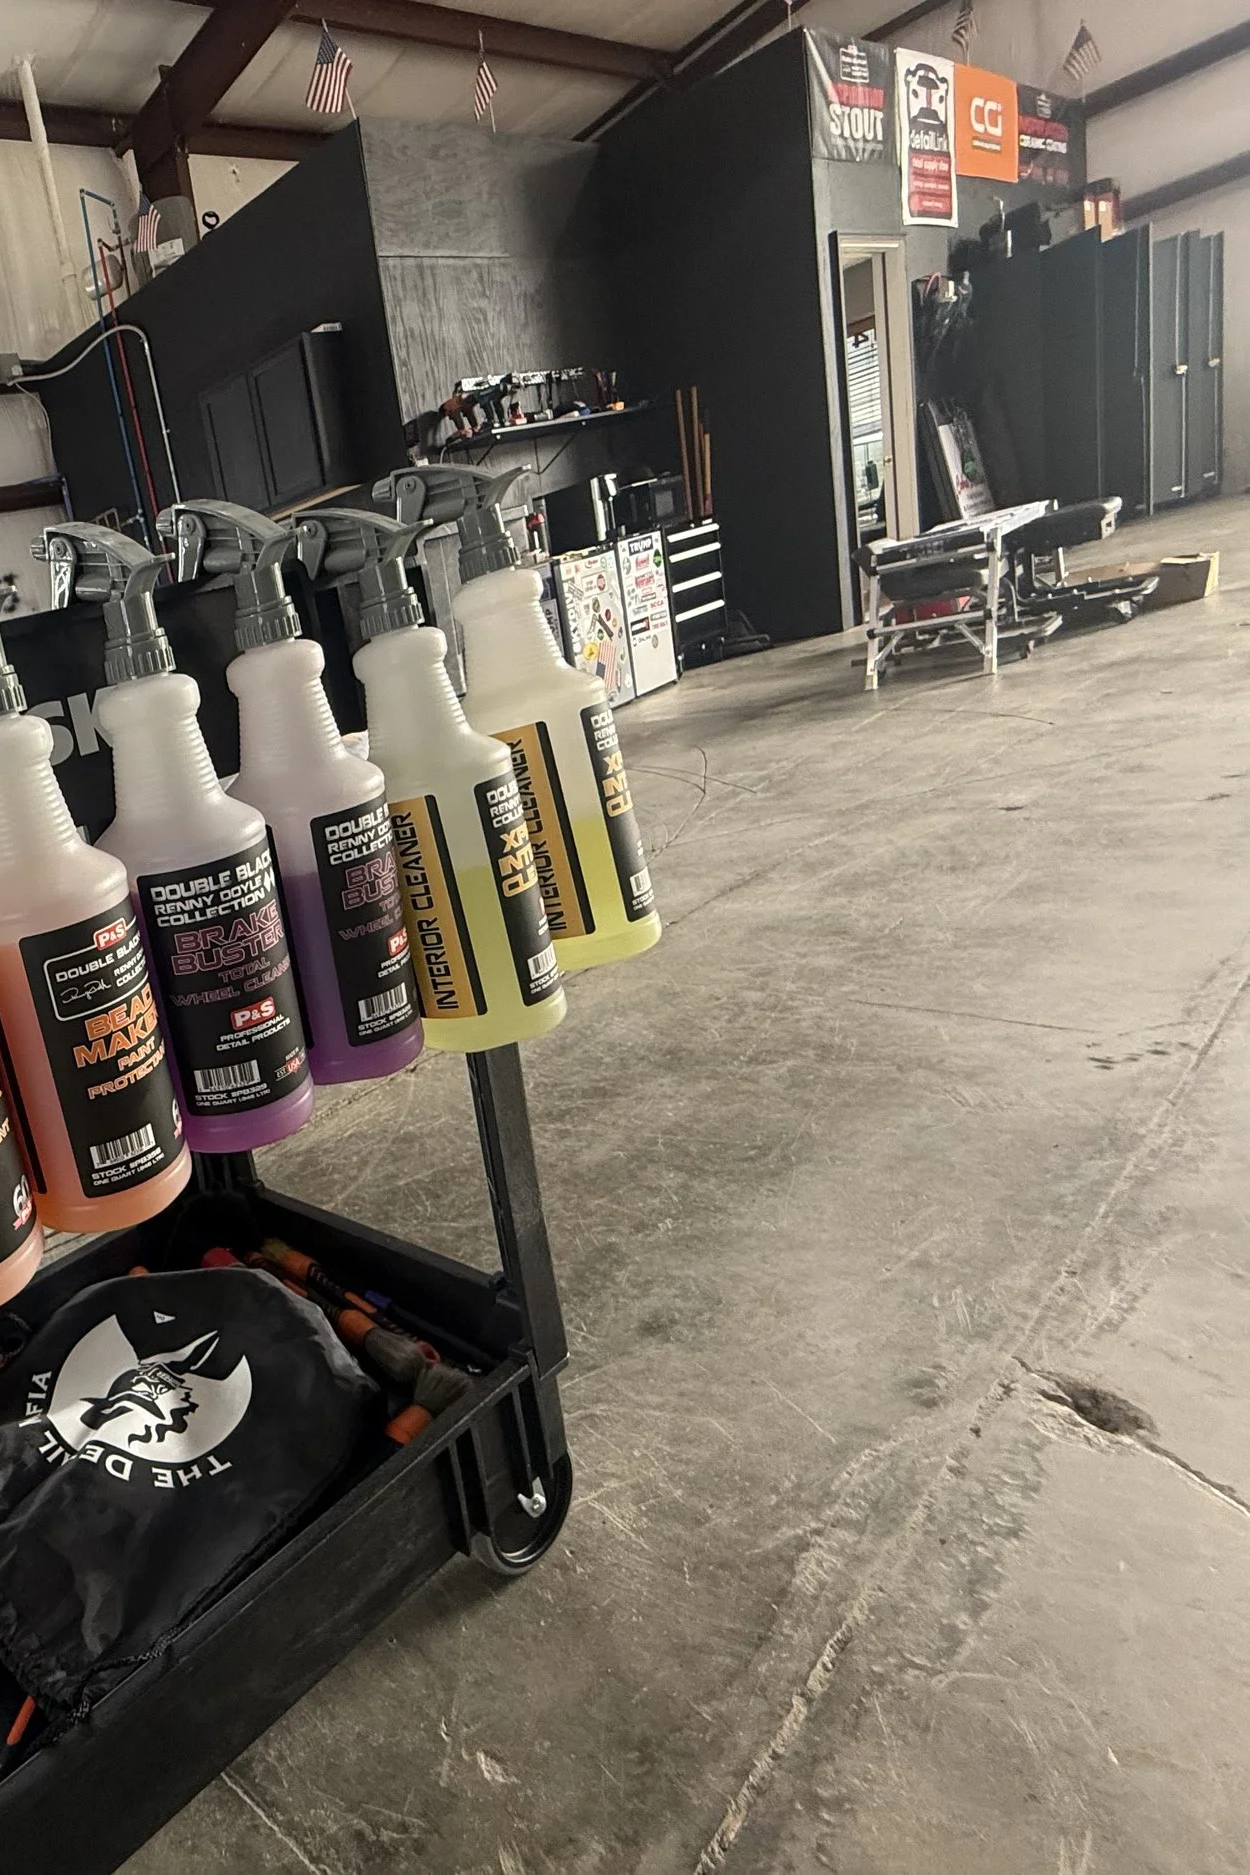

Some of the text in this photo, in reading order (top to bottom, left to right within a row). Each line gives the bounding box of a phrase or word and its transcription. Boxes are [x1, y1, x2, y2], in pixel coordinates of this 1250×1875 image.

[829, 103, 884, 140] STOUT
[325, 806, 383, 841] DOUBLE
[327, 829, 376, 854] RENNY
[391, 811, 435, 911] CLEANER
[150, 870, 232, 902] DOUBLE
[154, 875, 262, 915] RENNY DOYLE
[157, 887, 266, 928] COLLECTION
[97, 923, 126, 948] P&S
[174, 899, 280, 954] BRAKE
[171, 919, 285, 976] BUSTER
[417, 916, 459, 1010] INTERIOR
[55, 953, 114, 982] DOUBLE
[218, 957, 270, 983] TOTAL
[85, 983, 153, 1041] BEAD
[170, 986, 240, 1007] WHEEL
[220, 1014, 285, 1042] PROFESSIONAL
[234, 1001, 275, 1028] P&S
[358, 1017, 387, 1031] STOCK
[216, 1017, 291, 1051] DETAIL PRODUCTS
[118, 1036, 155, 1071] PAINT
[195, 1093, 228, 1101] STOCK
[92, 1165, 127, 1180] STOCK
[38, 1430, 134, 1482] DEAIL
[151, 1454, 234, 1489] THE
